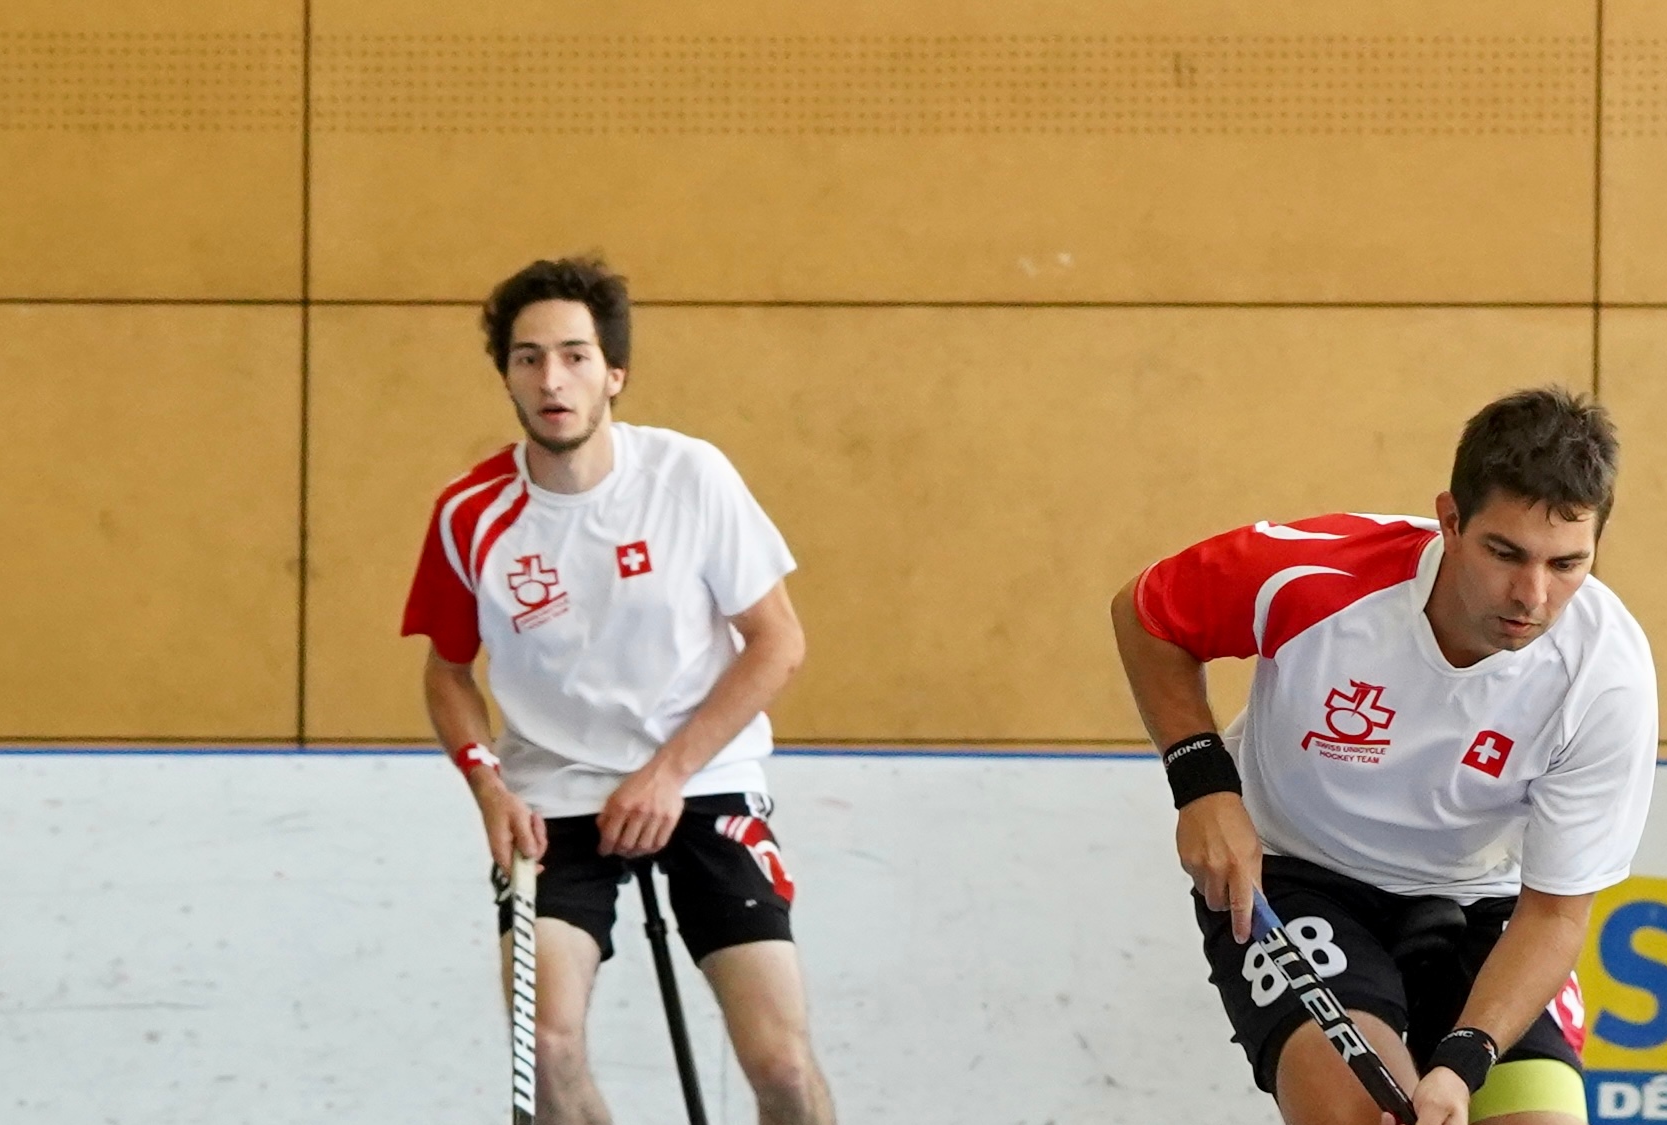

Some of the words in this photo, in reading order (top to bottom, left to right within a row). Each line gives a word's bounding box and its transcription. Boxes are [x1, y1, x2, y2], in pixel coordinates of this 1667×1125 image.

[1319, 750, 1354, 763] HOCKEY
[1356, 755, 1381, 765] TEAM
[1241, 915, 1348, 1008] 88
